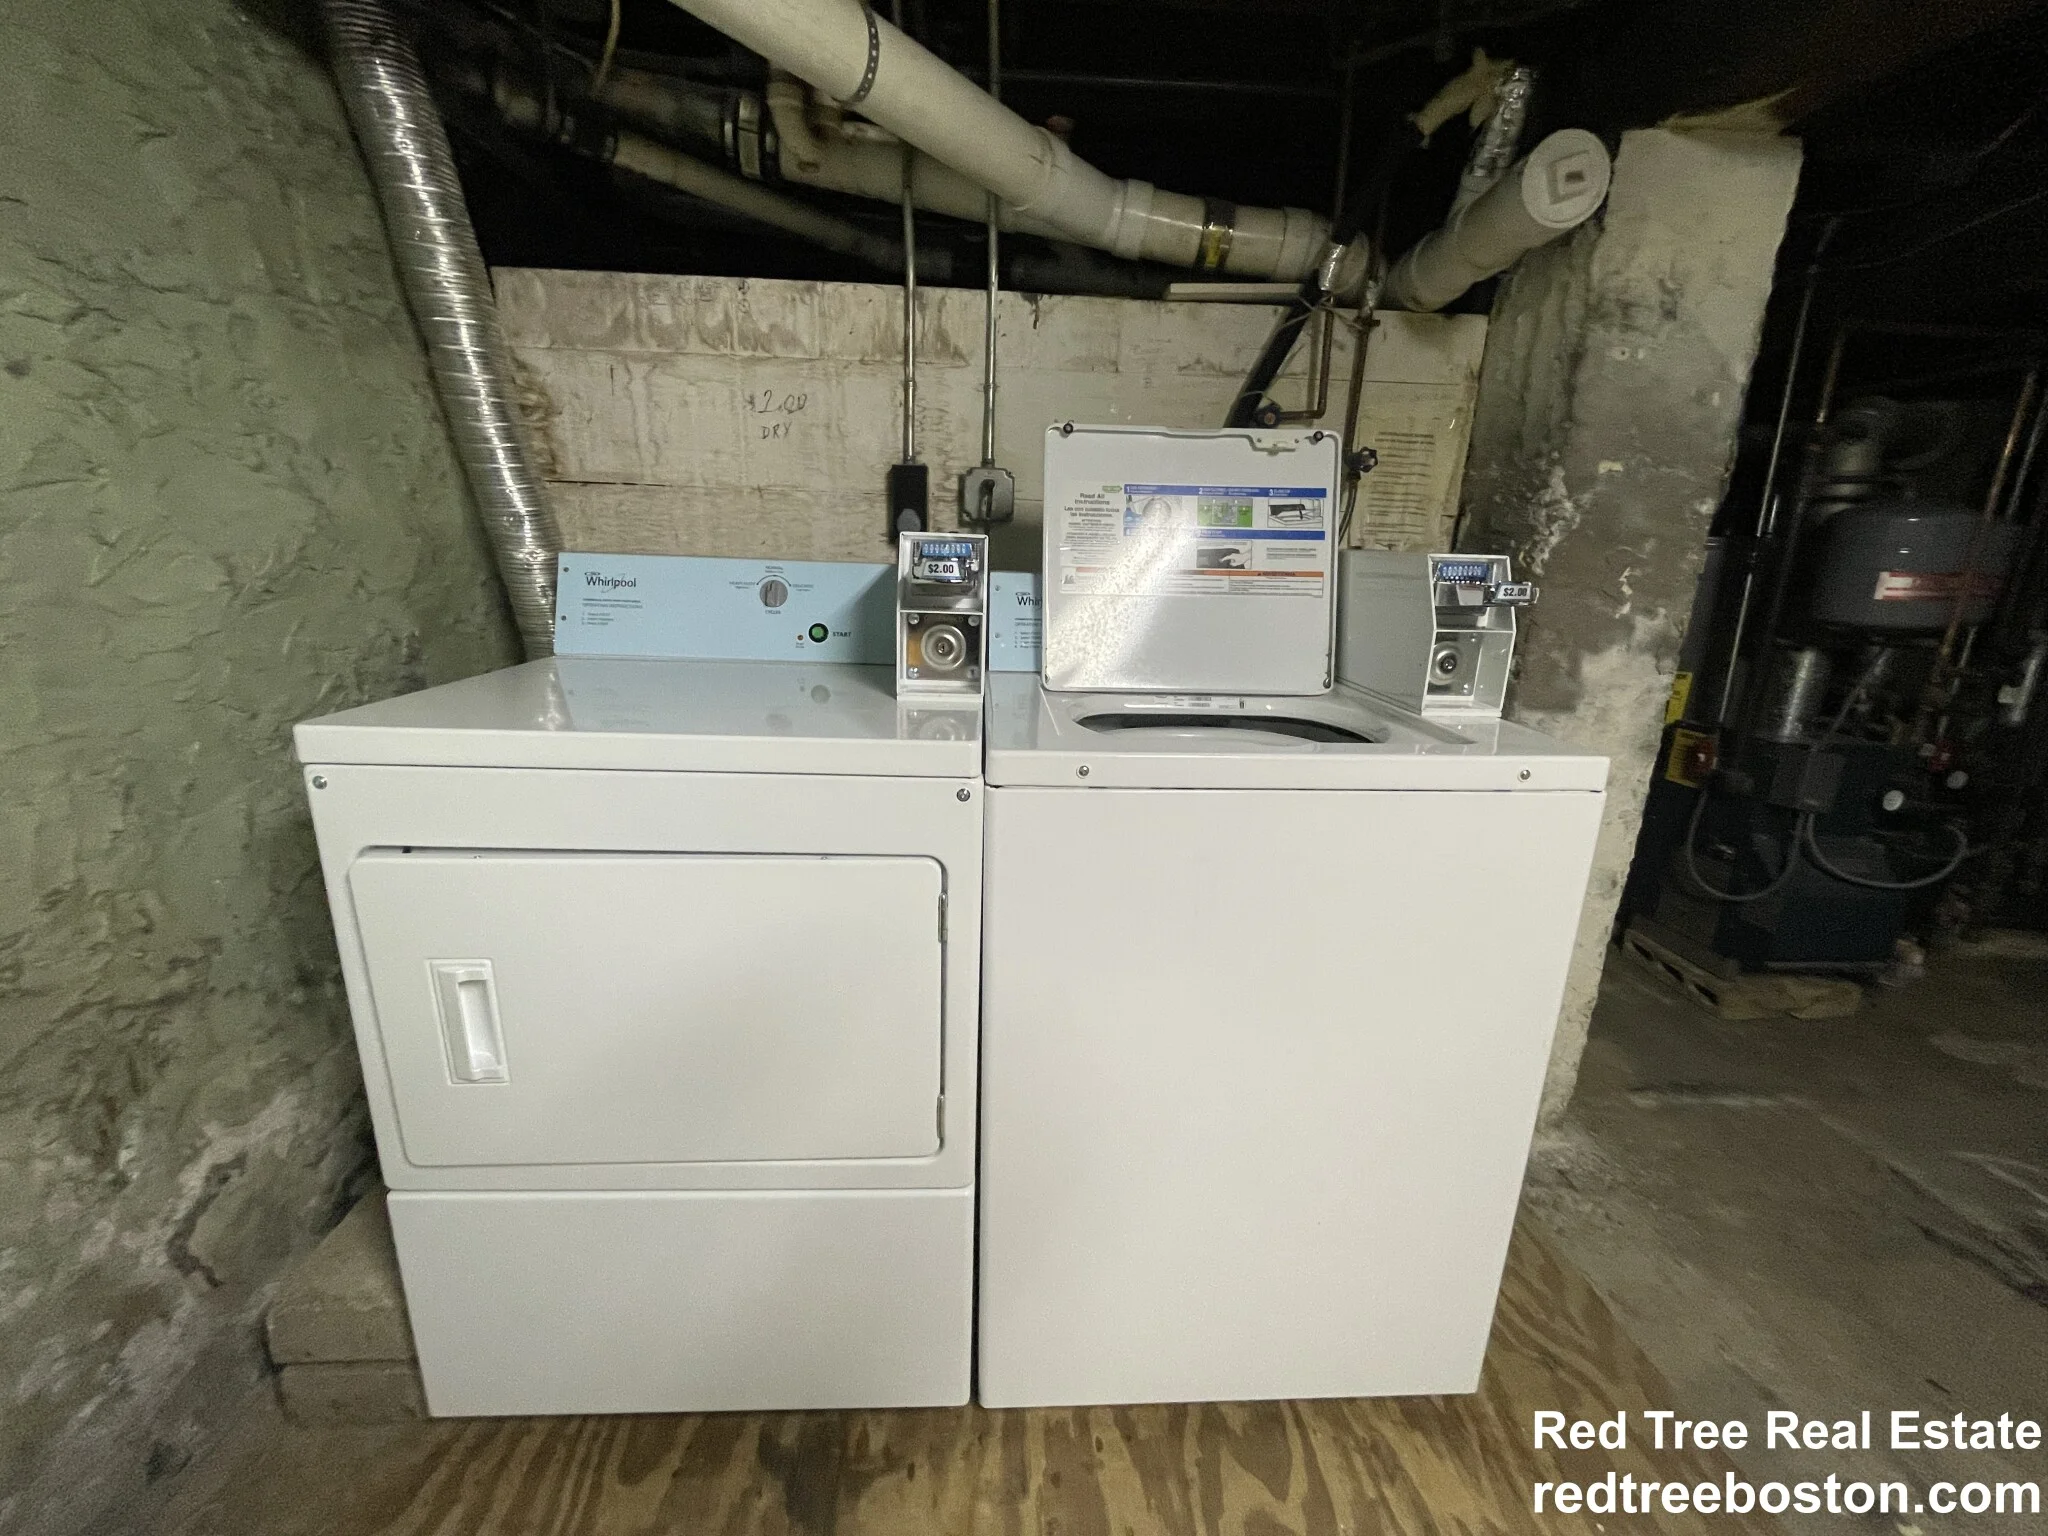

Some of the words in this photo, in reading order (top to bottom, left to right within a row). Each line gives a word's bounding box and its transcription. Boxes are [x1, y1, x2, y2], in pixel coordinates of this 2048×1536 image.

[761, 421, 793, 440] DRY
[928, 564, 954, 574] $2.00
[586, 576, 637, 589] Whirlpool
[1503, 588, 1528, 597] $2.00
